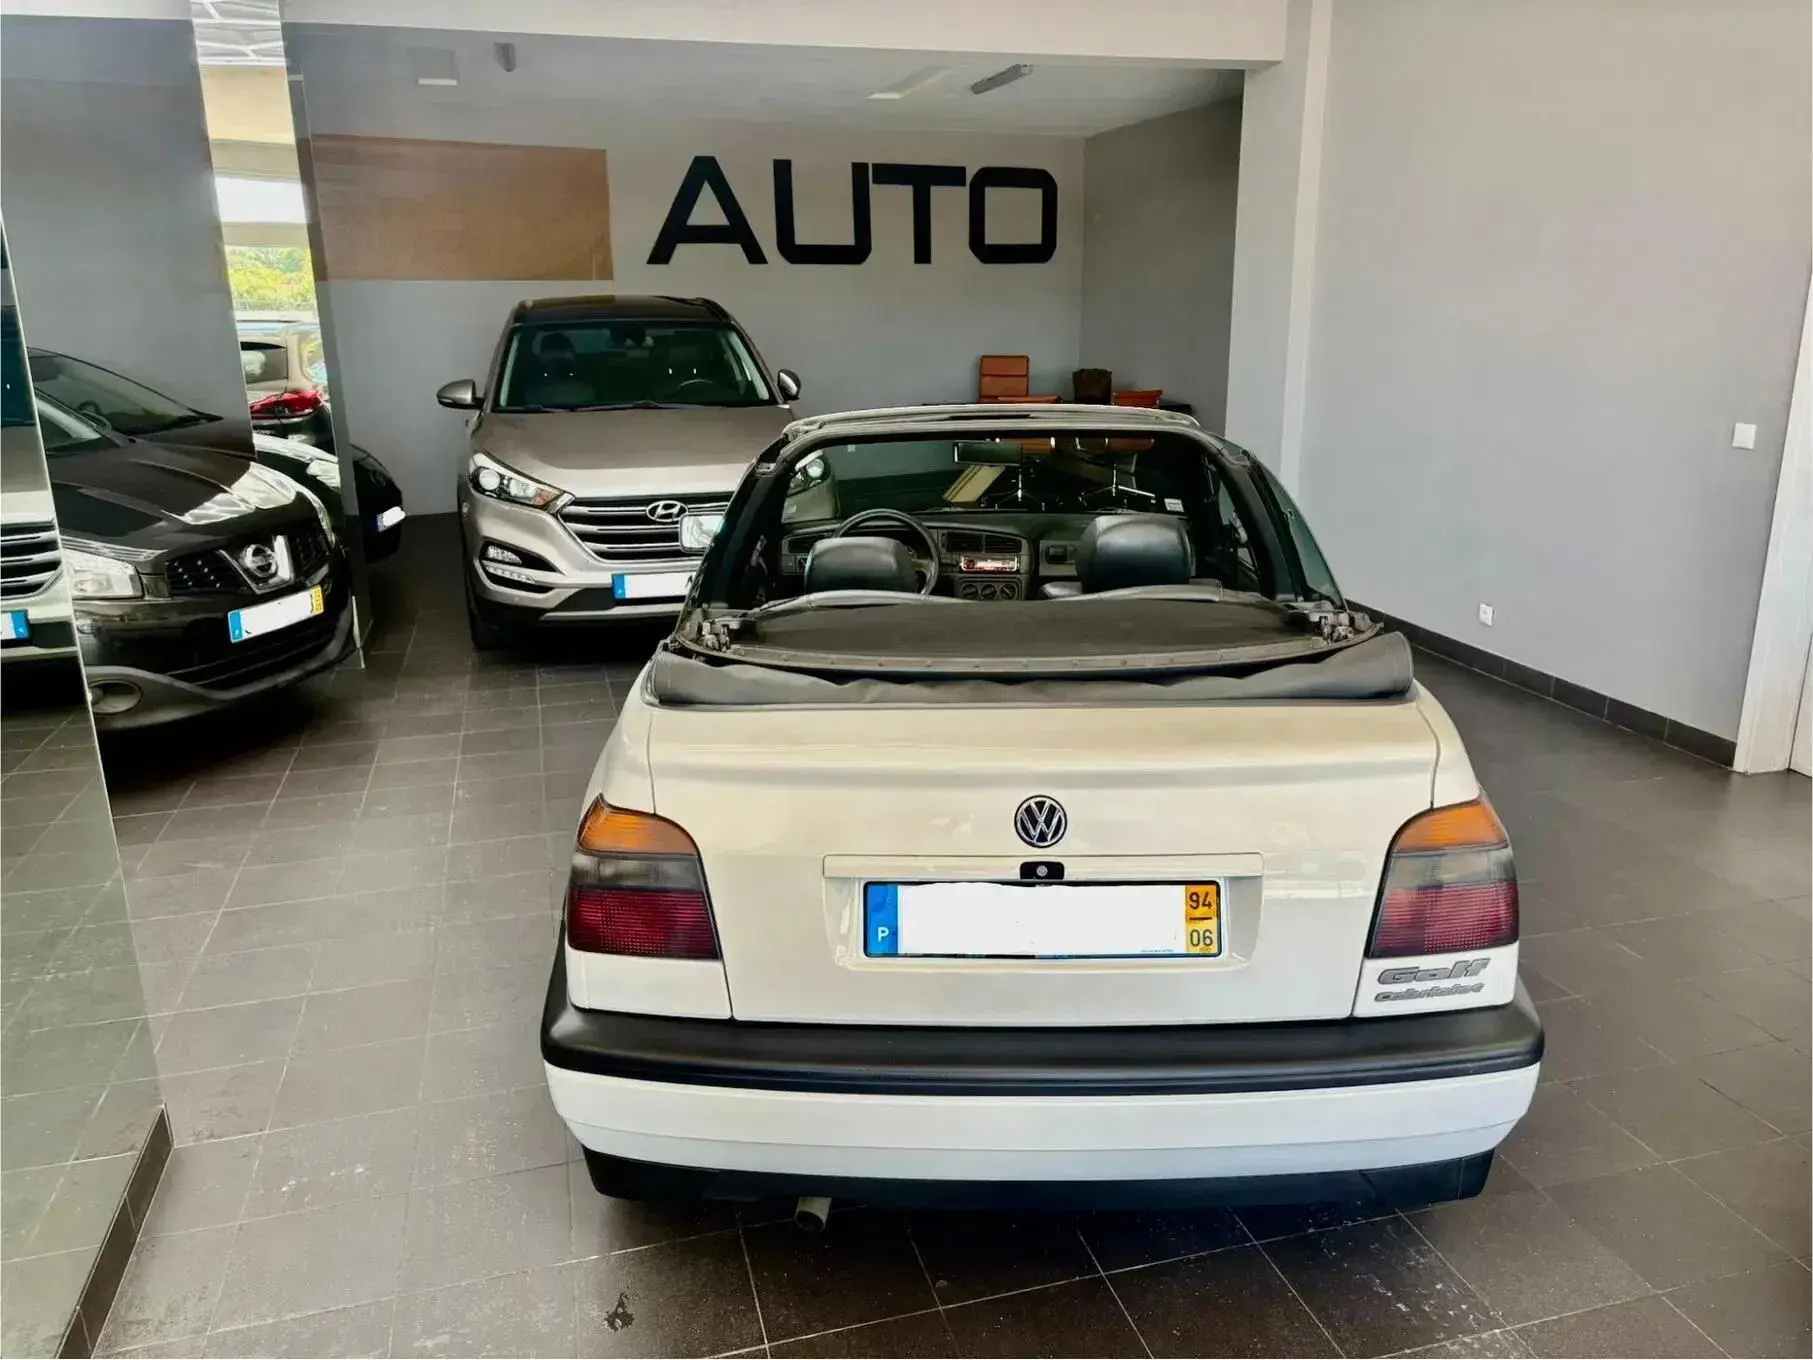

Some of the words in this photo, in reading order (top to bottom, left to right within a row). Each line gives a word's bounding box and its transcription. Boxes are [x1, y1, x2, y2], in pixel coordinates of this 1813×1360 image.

[646, 155, 1058, 265] AUTO
[1188, 891, 1213, 910] 94
[877, 926, 890, 942] P
[1189, 928, 1214, 947] 06
[1377, 957, 1491, 985] Golf
